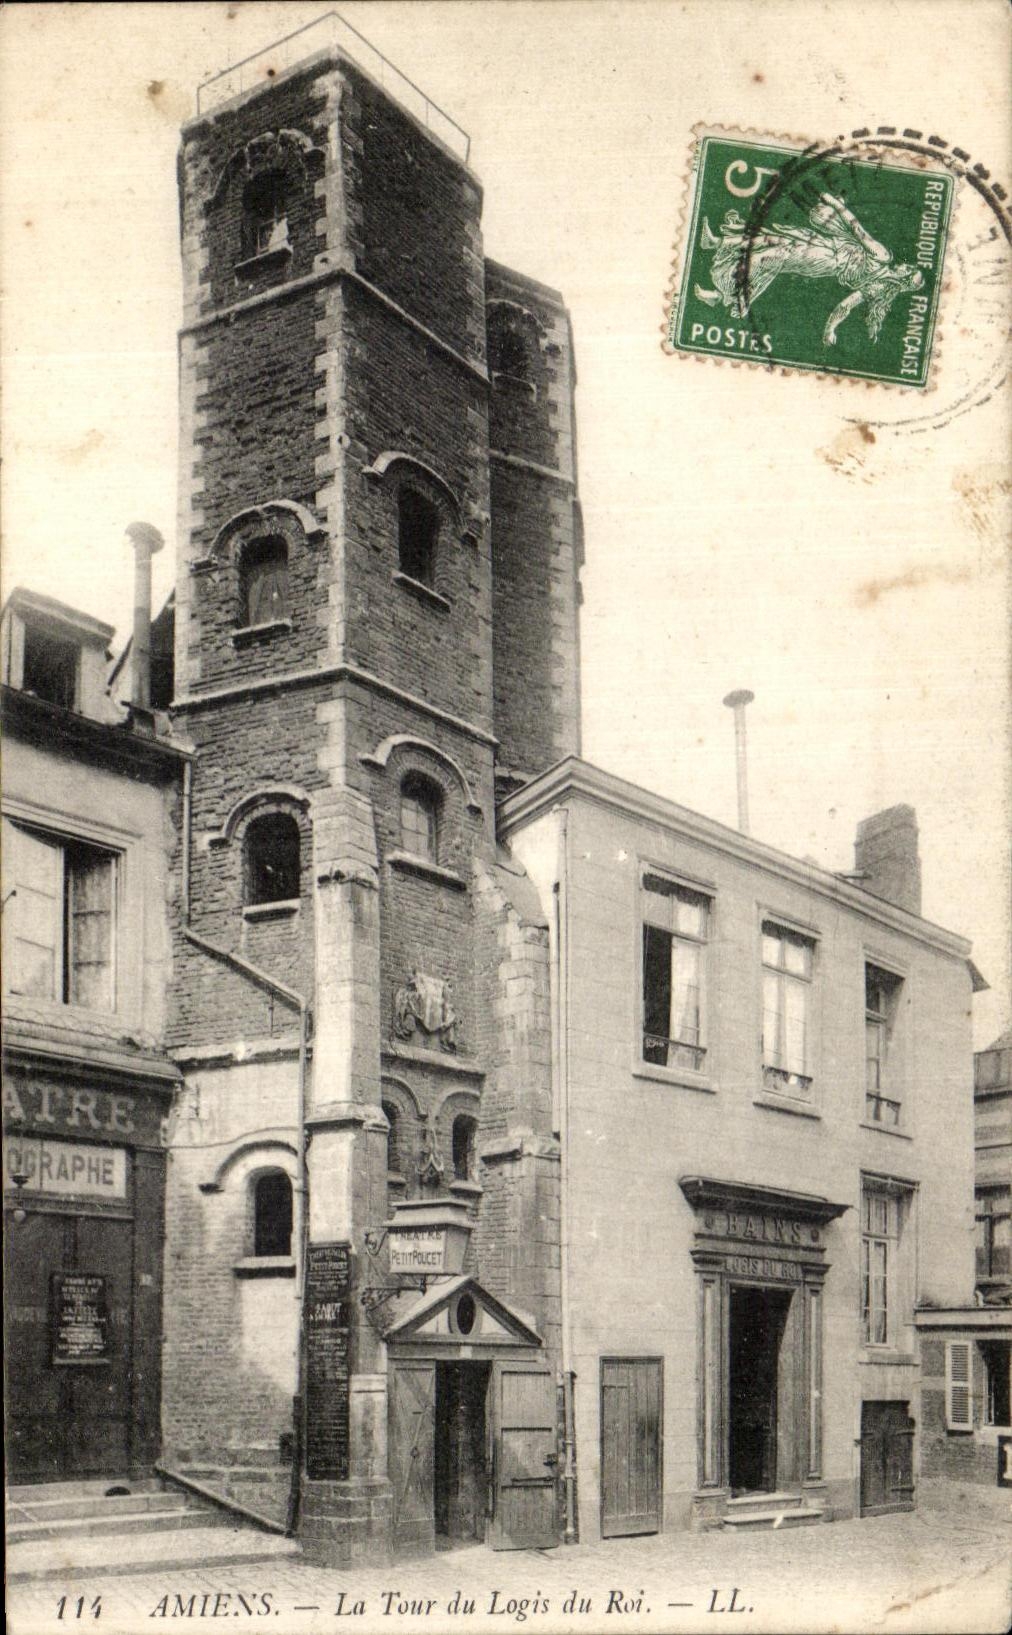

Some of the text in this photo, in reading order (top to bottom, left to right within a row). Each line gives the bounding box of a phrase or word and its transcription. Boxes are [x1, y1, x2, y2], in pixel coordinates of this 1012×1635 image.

[724, 159, 779, 198] 5
[691, 322, 773, 354] POSTES
[899, 294, 929, 377] FRANÇAISE
[725, 1213, 801, 1244] BAINS
